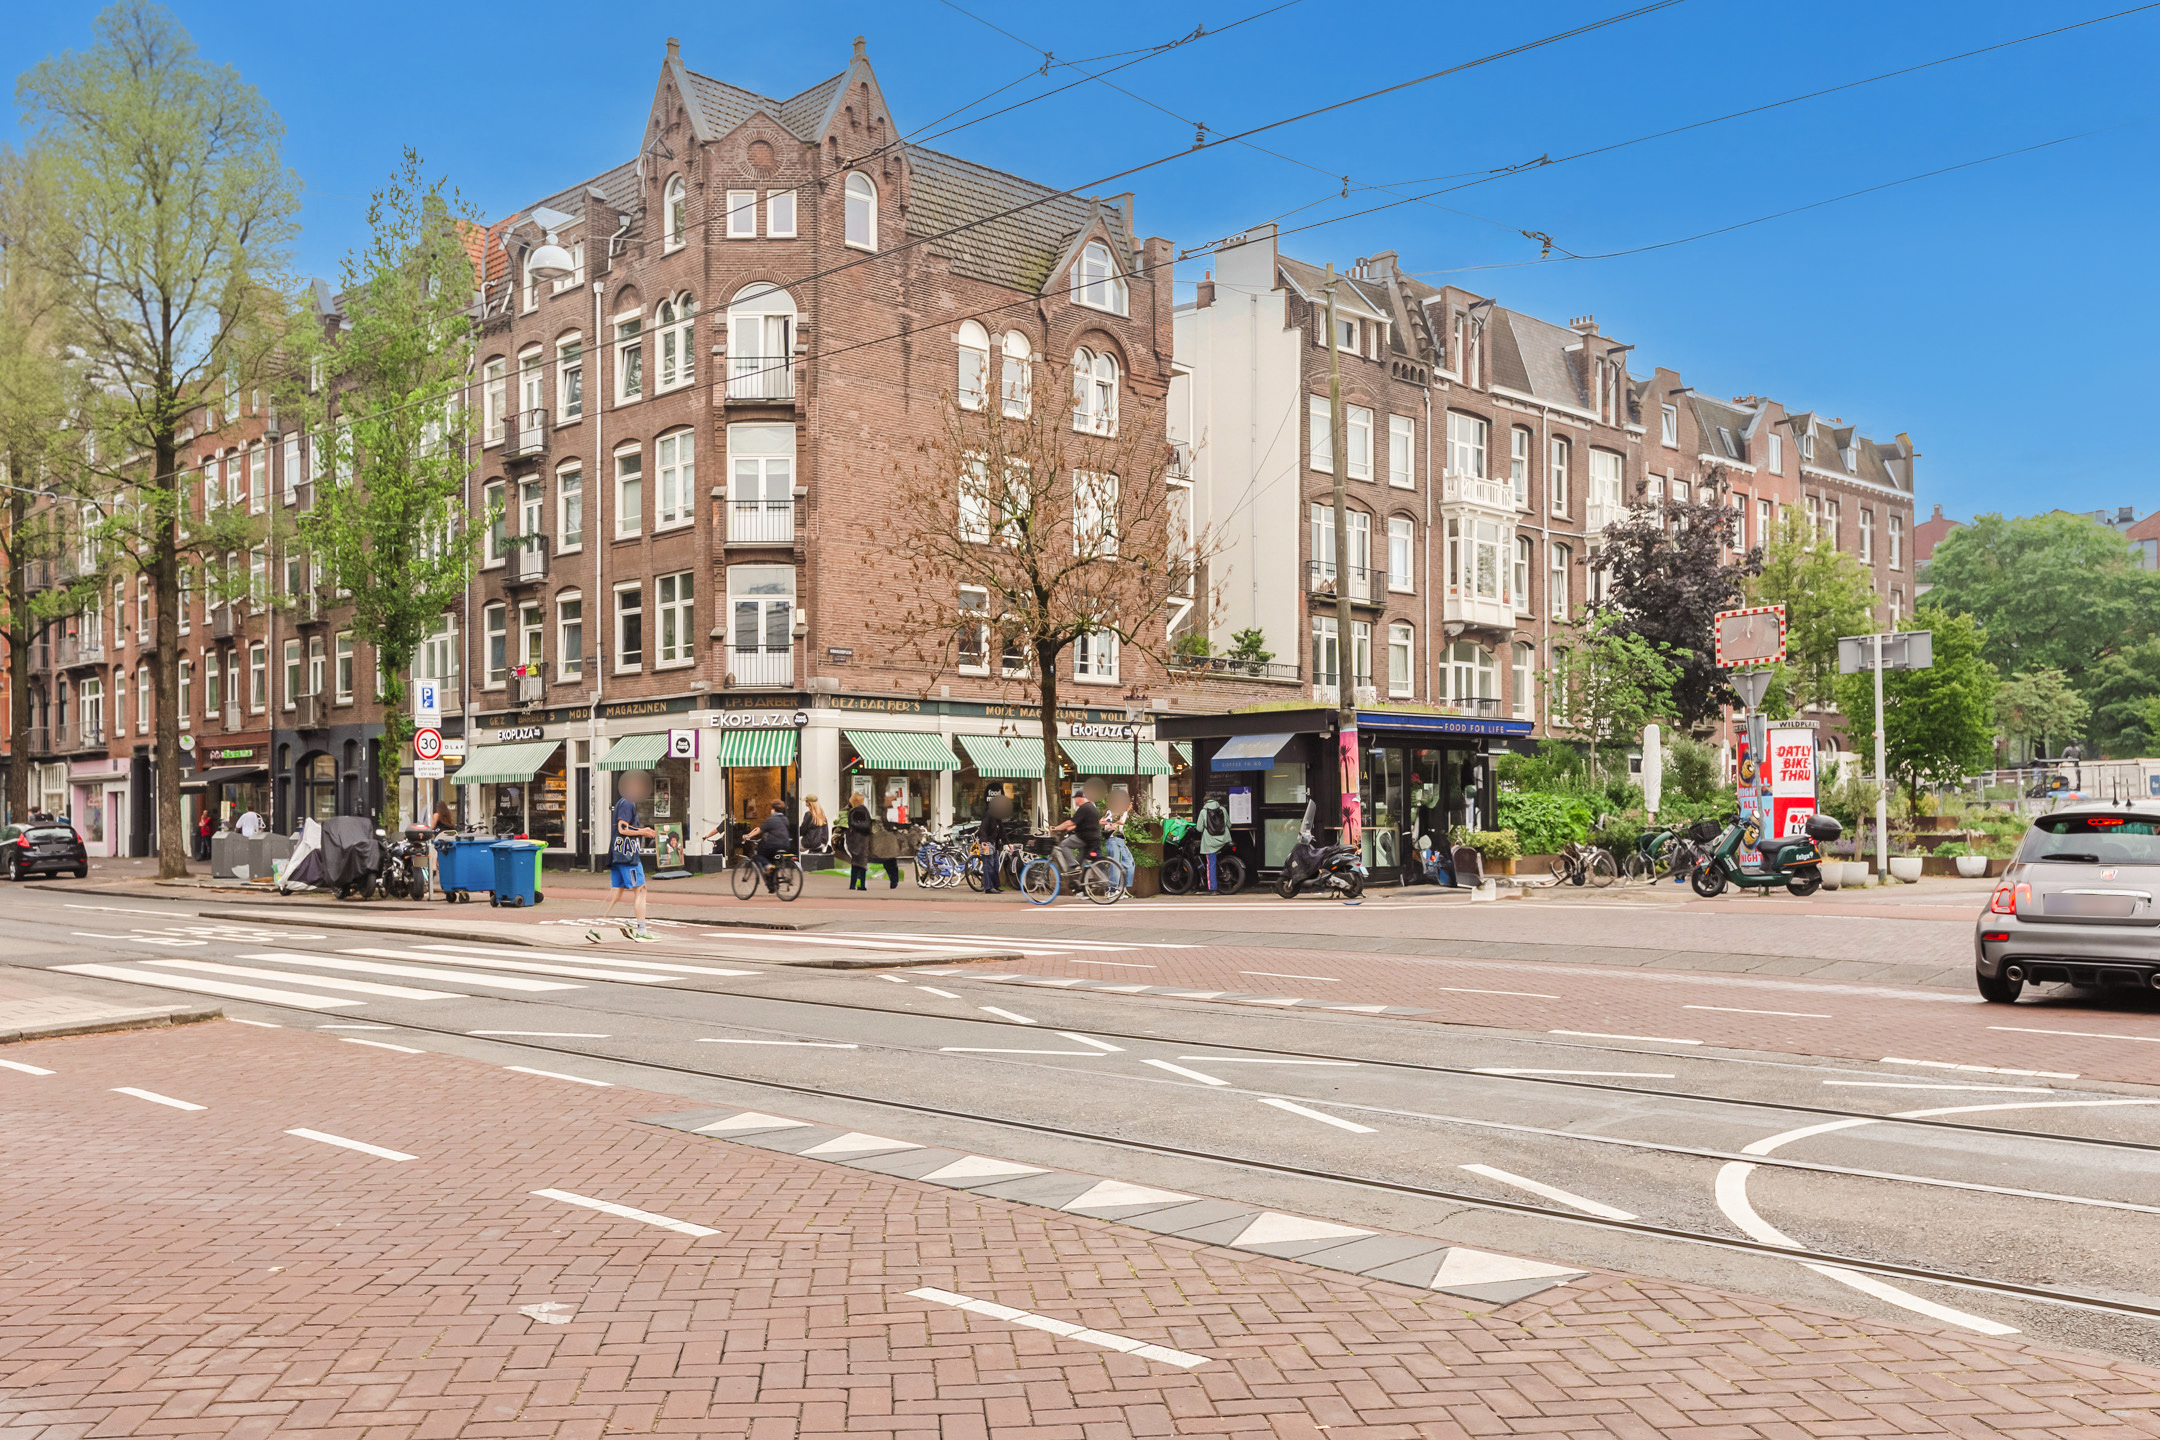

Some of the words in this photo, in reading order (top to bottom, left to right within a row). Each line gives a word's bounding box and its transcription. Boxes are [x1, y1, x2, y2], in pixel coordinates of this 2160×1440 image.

[424, 689, 431, 700] P
[606, 702, 667, 716] MAGAZIJNEN
[710, 713, 791, 727] EKOPLAZA
[498, 729, 533, 740] EKOPLAZA
[1072, 725, 1122, 737] EKOPLAZA
[1444, 723, 1467, 732] FOOD
[1470, 724, 1485, 733] FOR
[1488, 725, 1504, 734] LIFE
[421, 739, 438, 750] 30
[1777, 745, 1812, 757] OATLY
[1783, 757, 1811, 769] BIKE-
[1780, 769, 1811, 782] THRU
[1743, 800, 1758, 809] ALL
